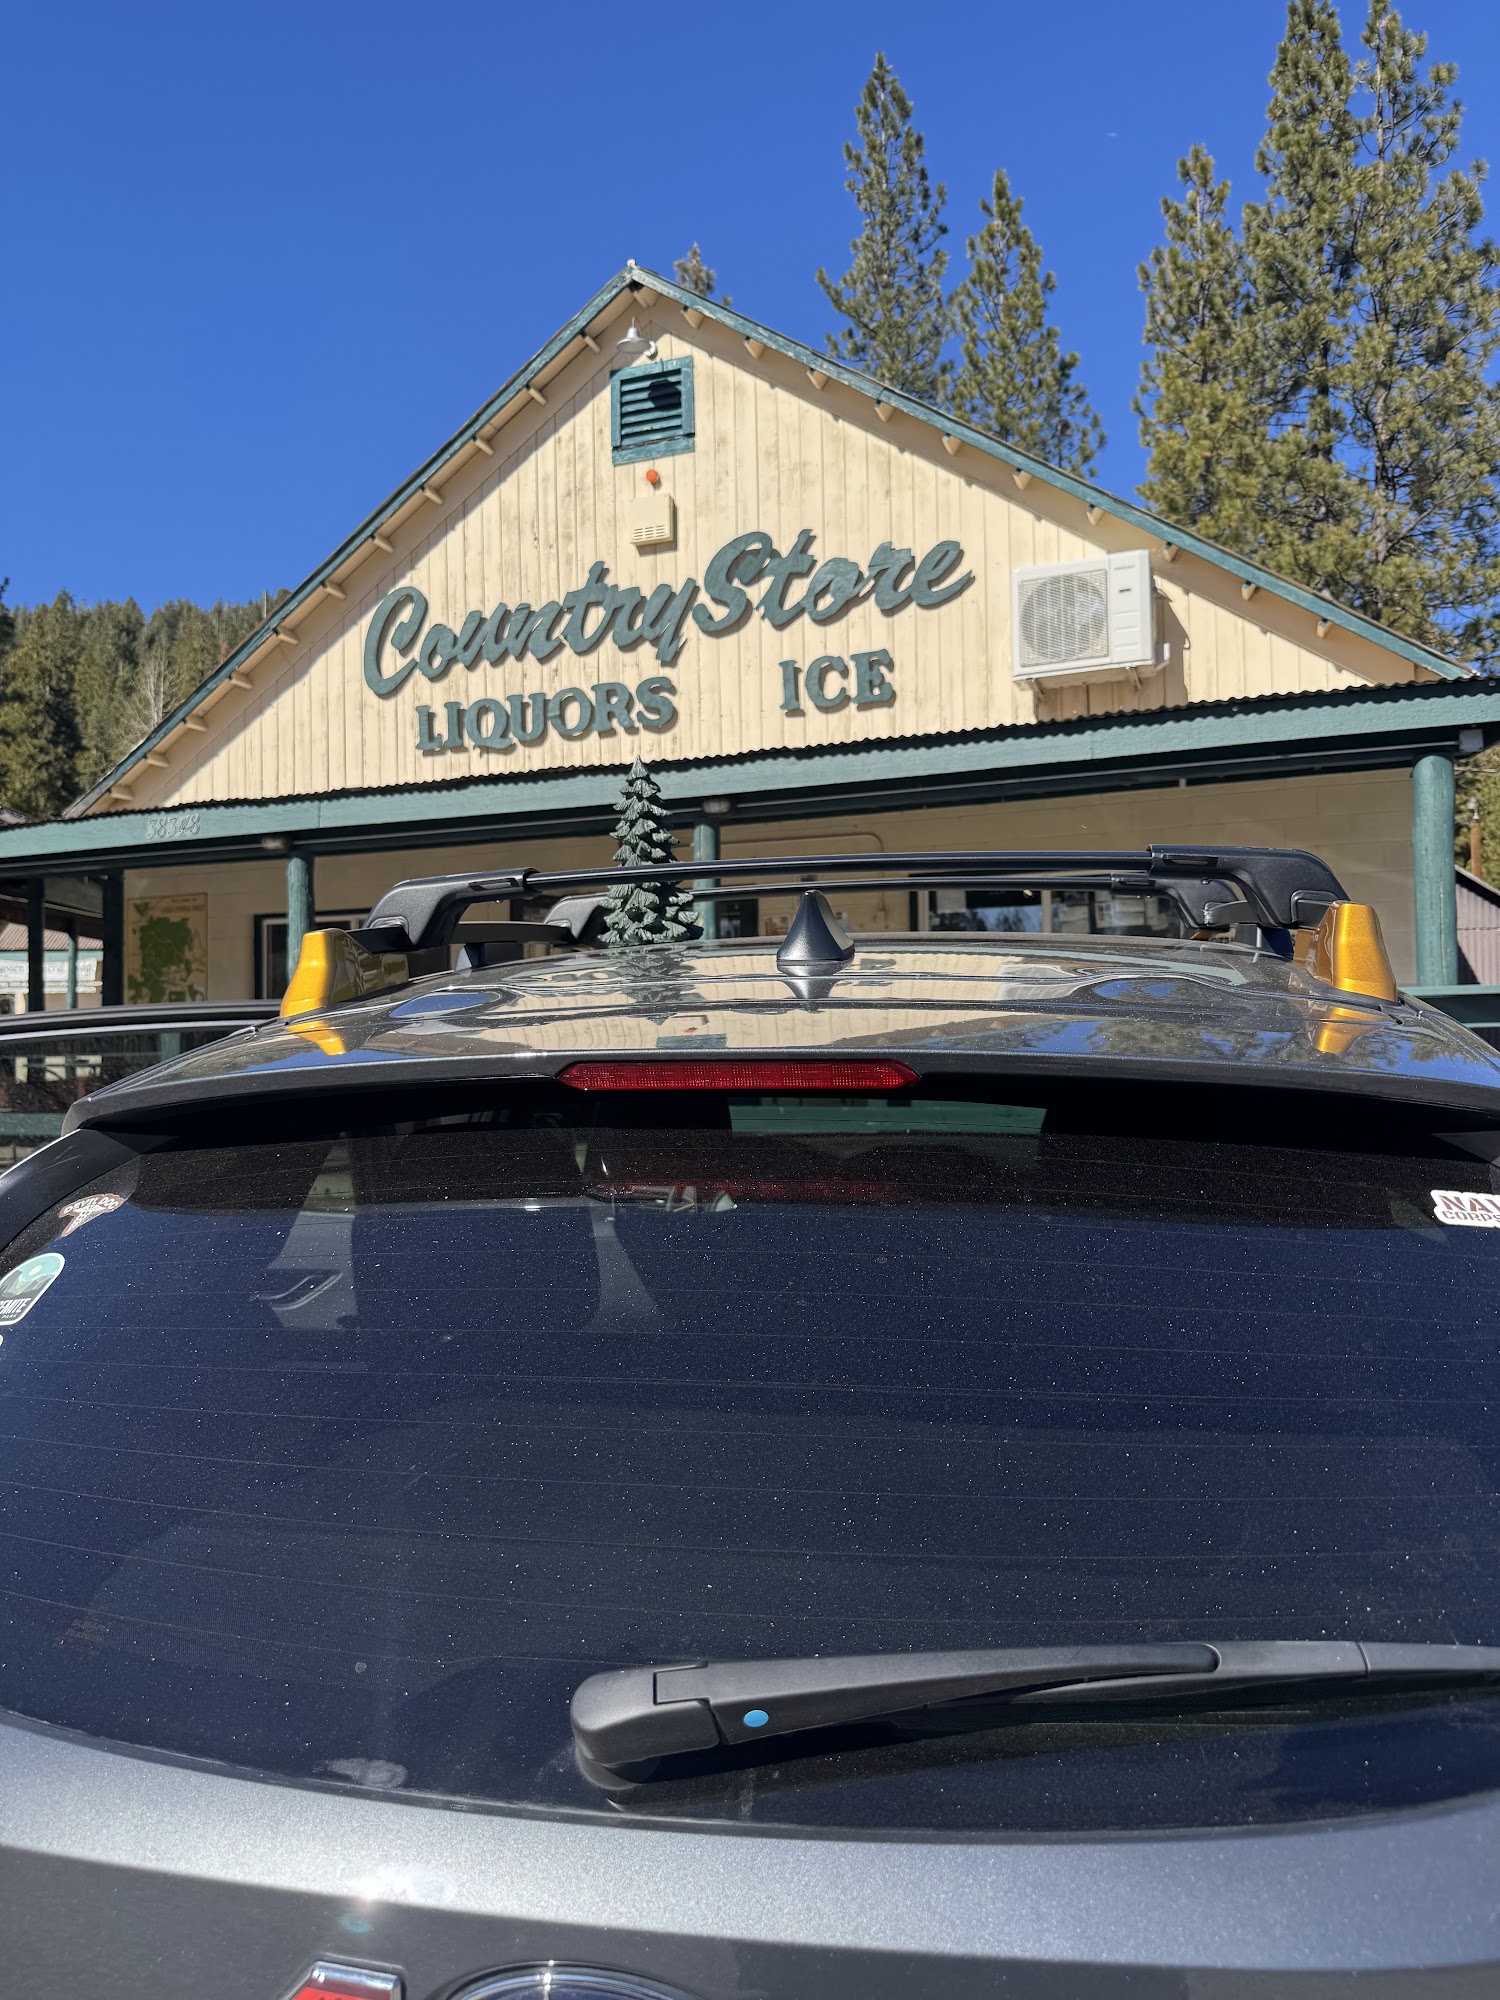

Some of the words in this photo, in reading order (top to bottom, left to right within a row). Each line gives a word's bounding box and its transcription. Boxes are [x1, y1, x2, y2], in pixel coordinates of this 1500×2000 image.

[364, 561, 700, 698] Country
[692, 529, 972, 636] Store
[415, 677, 676, 756] LIQUORS
[779, 648, 894, 715] ICE
[146, 814, 200, 840] 38348
